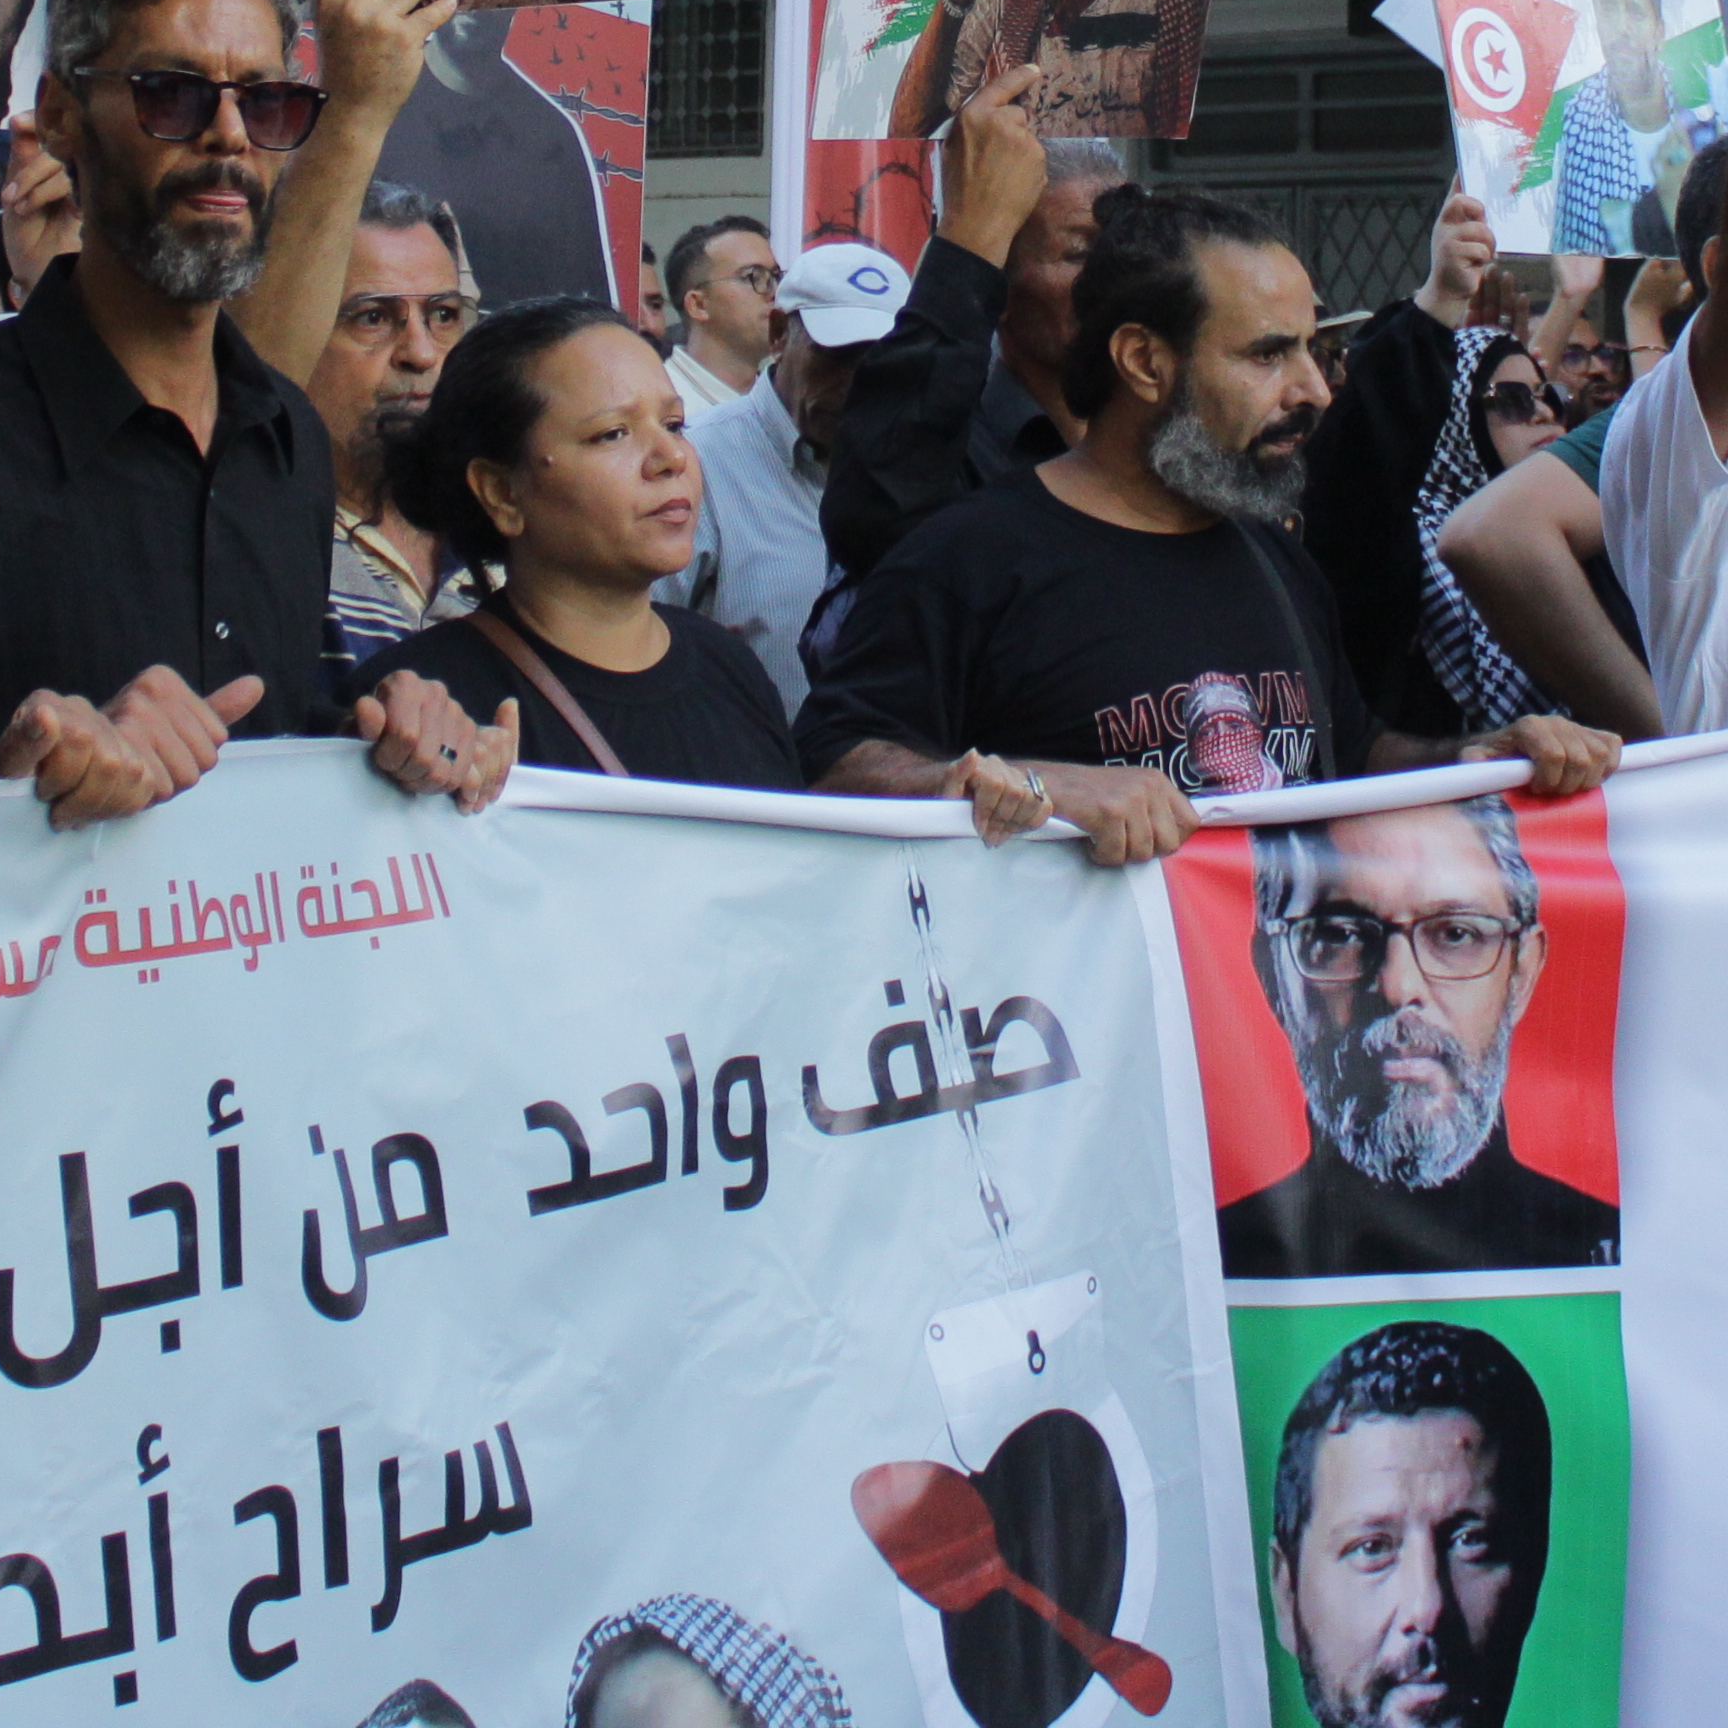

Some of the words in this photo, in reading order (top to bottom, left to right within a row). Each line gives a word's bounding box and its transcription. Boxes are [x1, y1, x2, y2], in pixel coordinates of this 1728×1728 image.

[74, 868, 280, 984] الوطنية
[298, 852, 452, 949] اللجنة
[526, 1033, 768, 1215] واحد
[803, 979, 1081, 1137] صف
[301, 1123, 448, 1322] من
[227, 1418, 534, 1683] سراح
